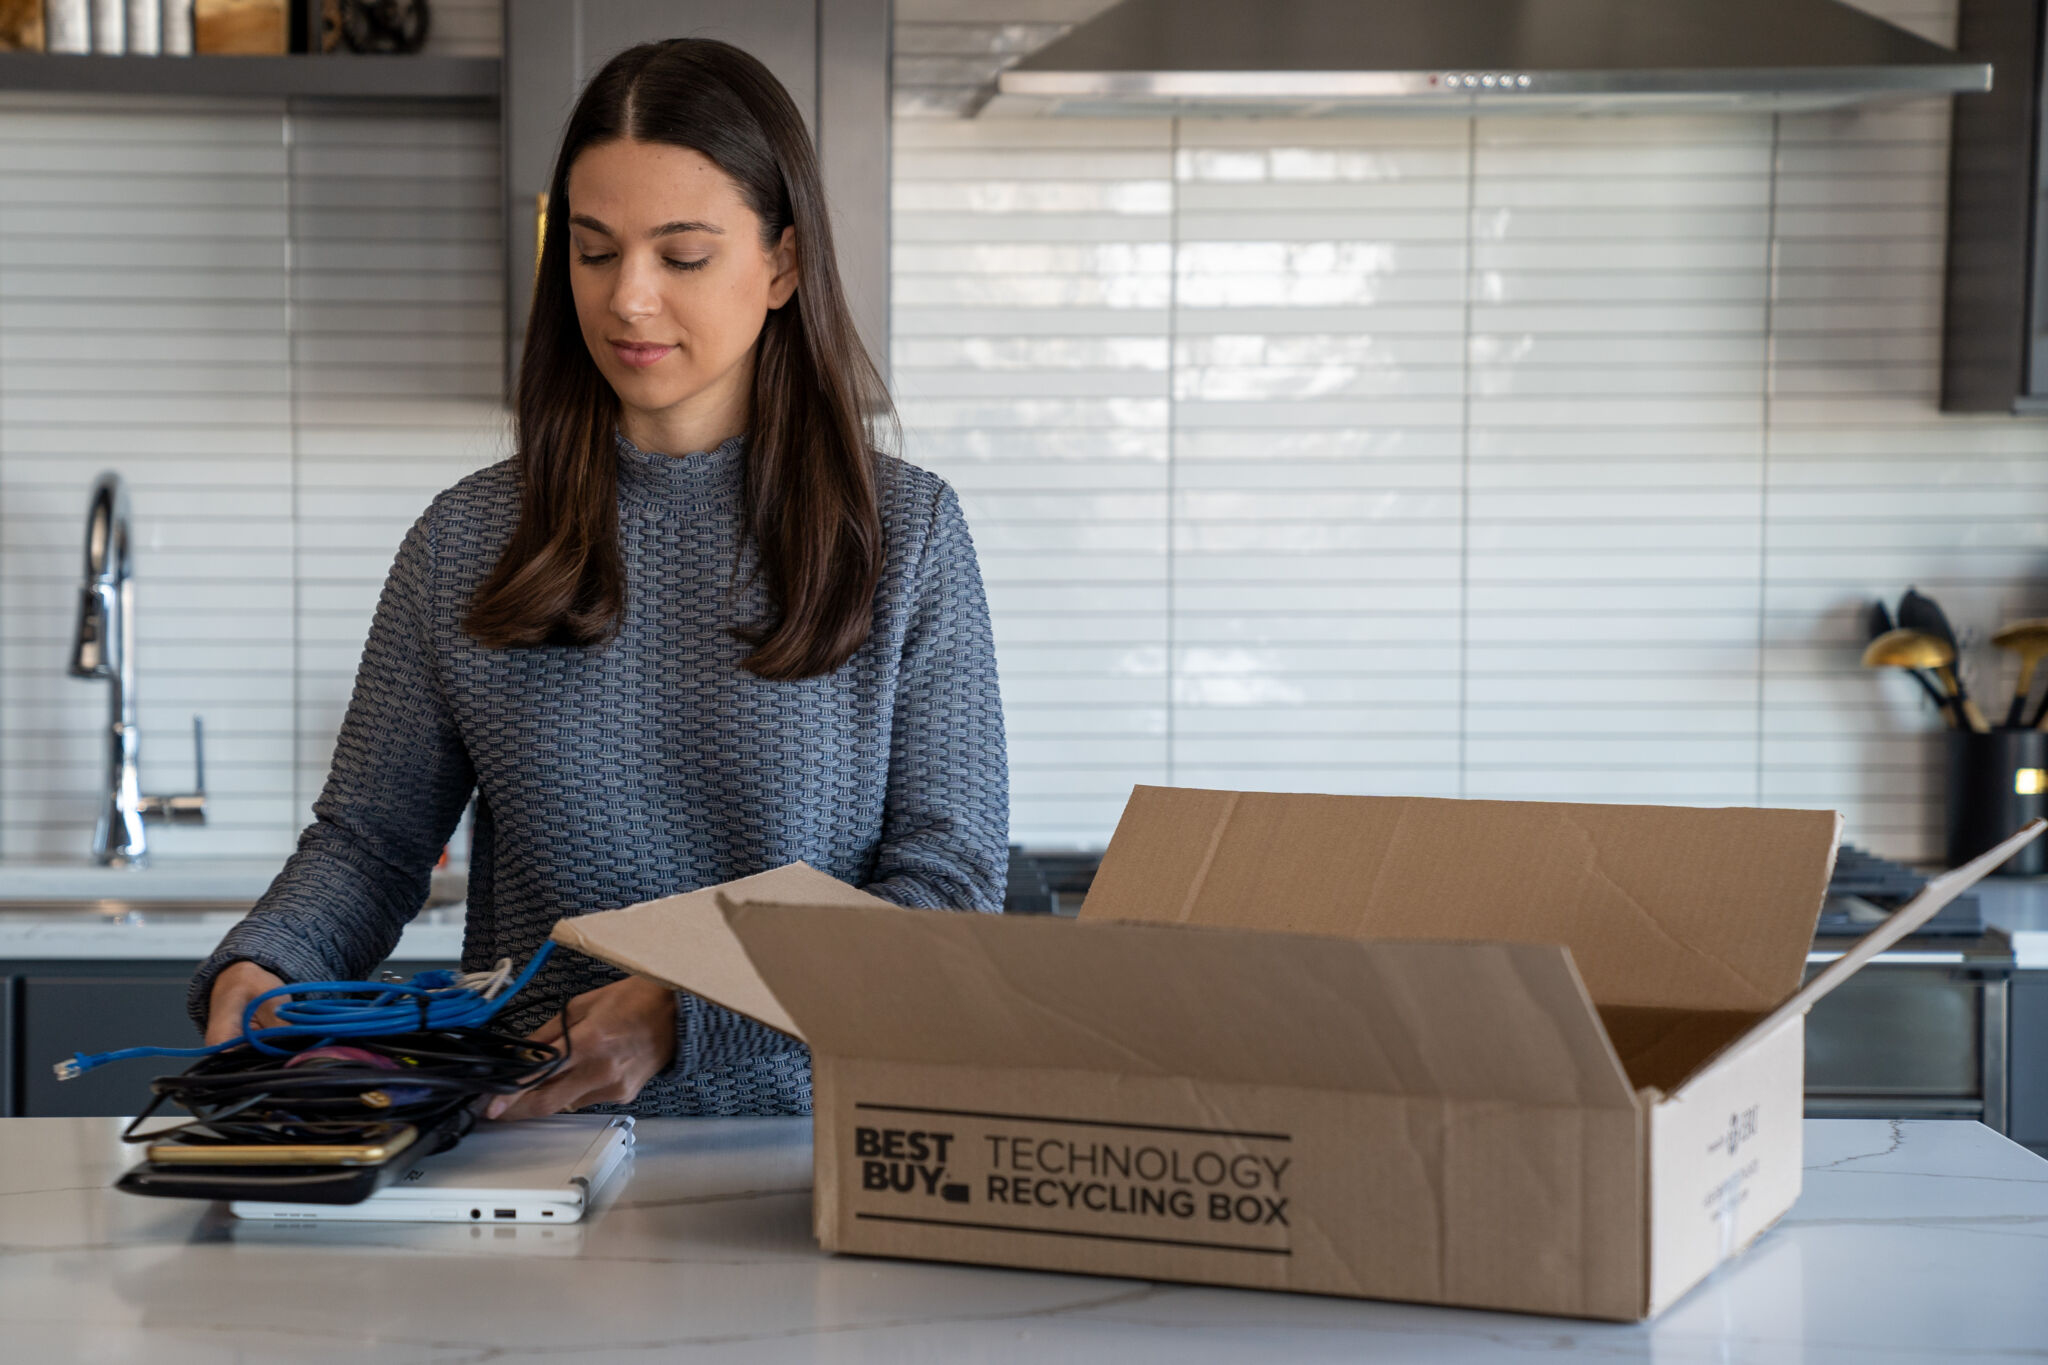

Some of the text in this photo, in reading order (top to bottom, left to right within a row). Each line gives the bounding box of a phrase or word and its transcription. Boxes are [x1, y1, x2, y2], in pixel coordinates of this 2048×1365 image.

[855, 1127, 954, 1163] BEST
[984, 1135, 1291, 1191] TECHNOLOGY
[986, 1174, 1290, 1227] RECYCLING BOX
